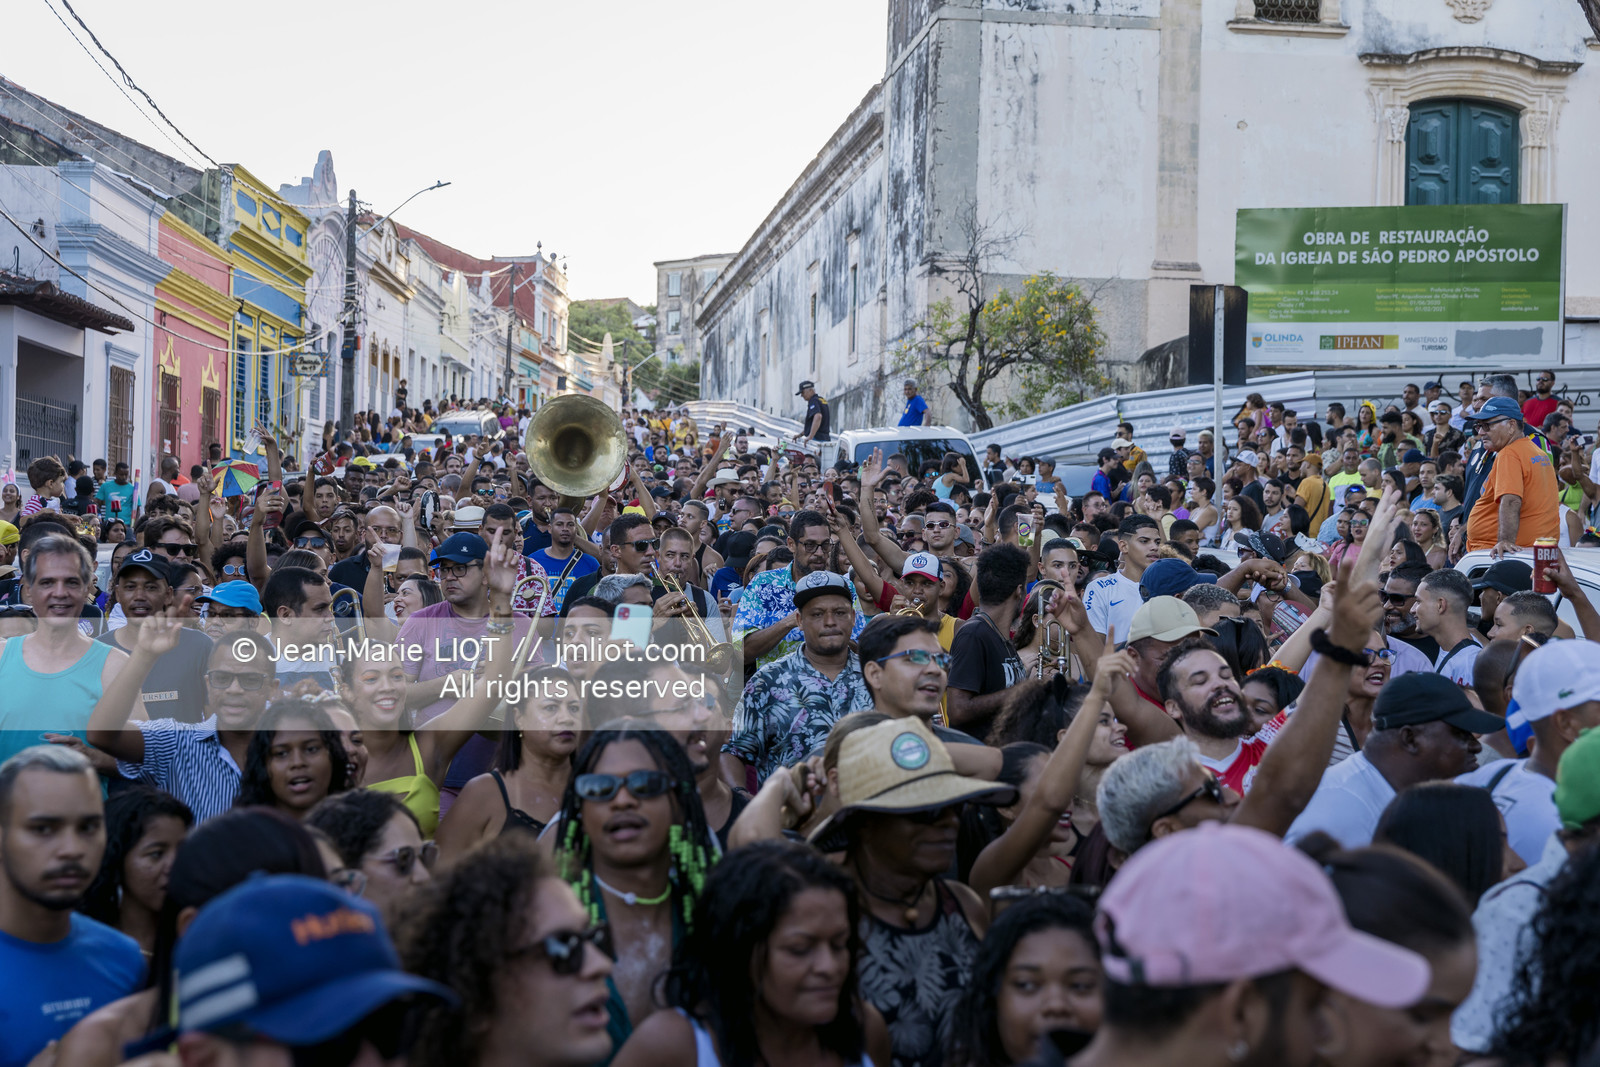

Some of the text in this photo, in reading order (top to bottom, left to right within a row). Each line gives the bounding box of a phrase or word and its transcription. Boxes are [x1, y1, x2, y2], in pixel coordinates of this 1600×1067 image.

[1303, 226, 1490, 246] OBRA DE RESTAURAÇÃO
[1255, 245, 1540, 265] DA IGREJA DE SÃO PEDRO APÓSTOLO
[1264, 334, 1304, 342] OLINDA
[1337, 336, 1382, 349] IPHAN
[1538, 548, 1559, 560] BRA
[1085, 590, 1095, 610] vivo
